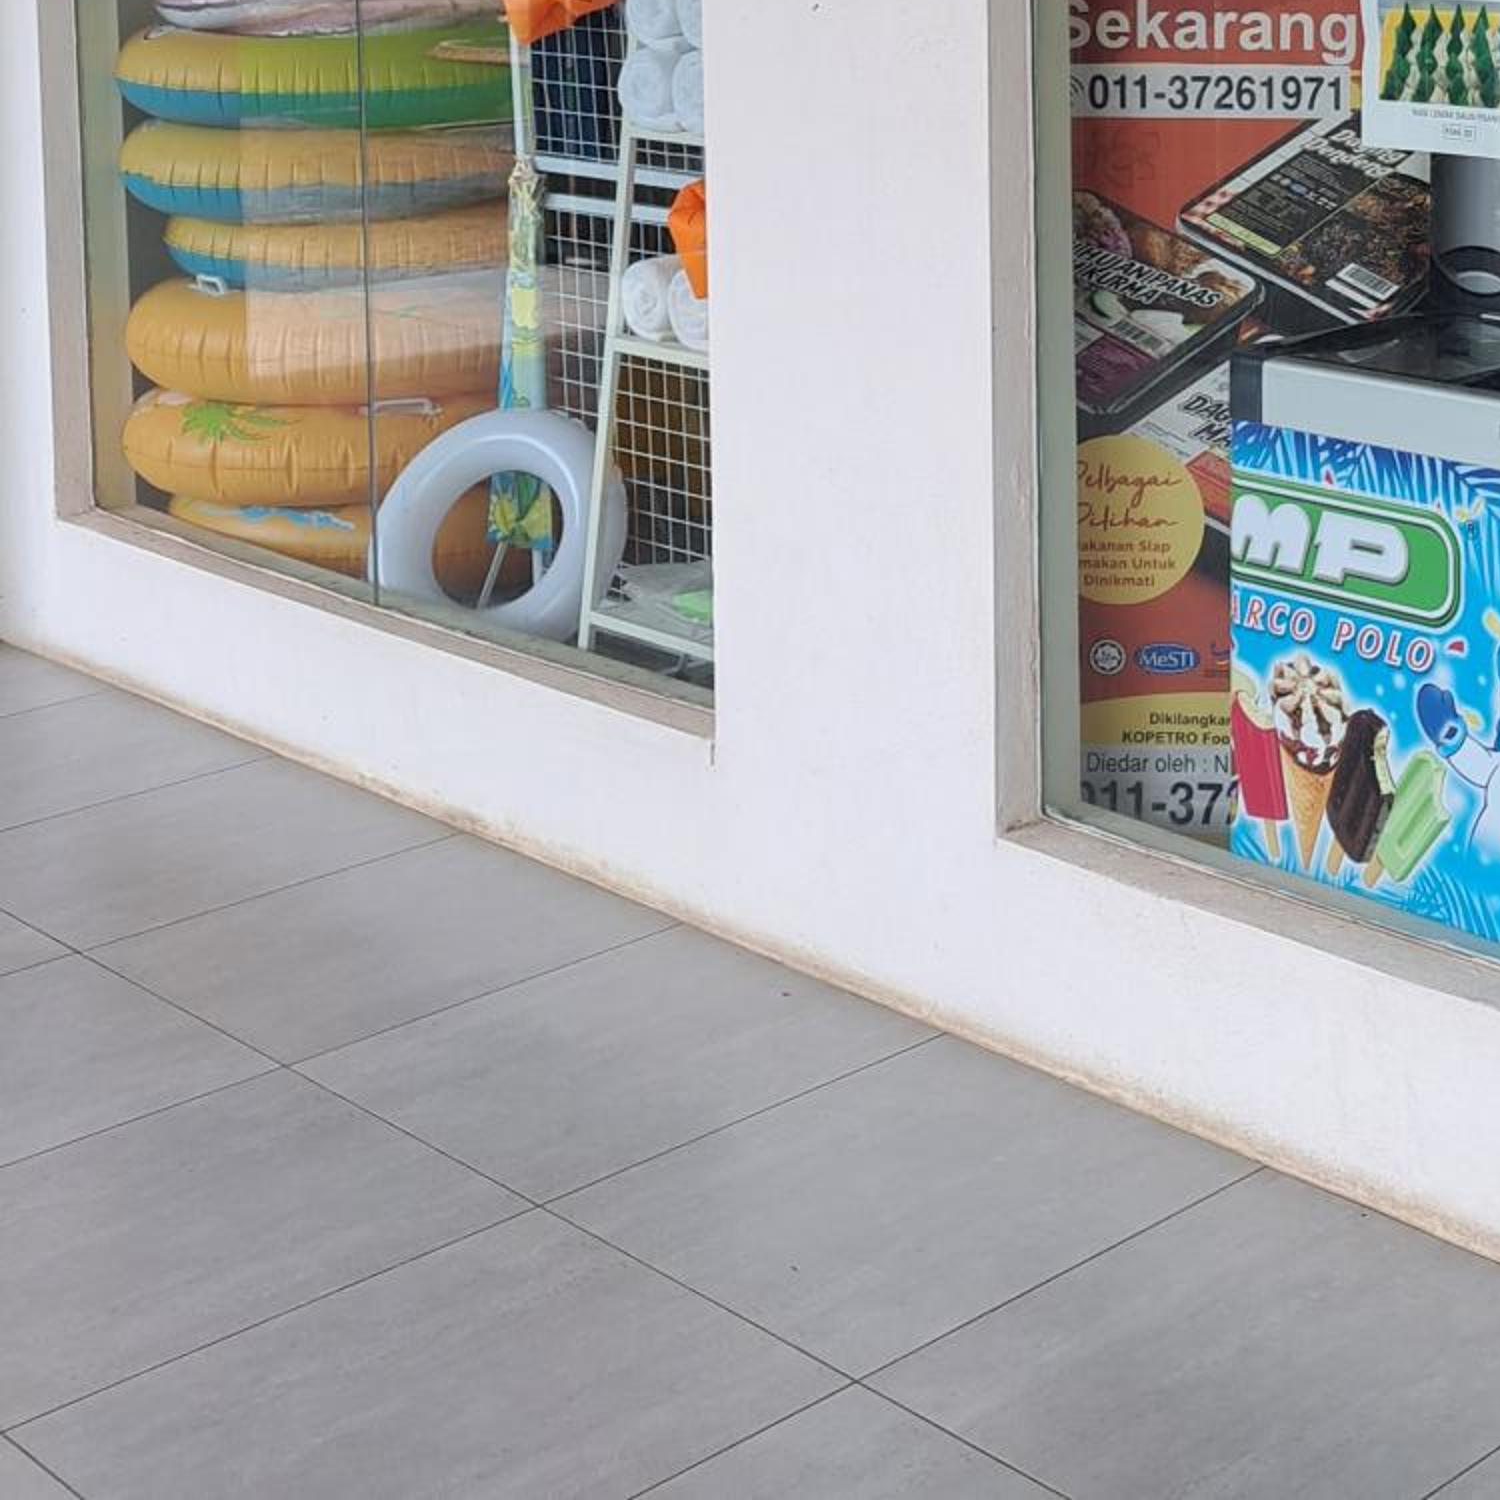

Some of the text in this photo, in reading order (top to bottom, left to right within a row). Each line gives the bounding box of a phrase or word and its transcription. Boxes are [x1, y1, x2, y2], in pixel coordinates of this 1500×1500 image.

[1087, 74, 1343, 111] 011-37261971
[1080, 540, 1135, 552] akanan
[1132, 556, 1176, 570] Untuk
[1083, 573, 1155, 587] Dinikmati
[1331, 618, 1437, 674] POLO
[1121, 730, 1198, 745] KOPETRO
[1086, 752, 1149, 774] Diedar
[1154, 752, 1196, 774] oleh
